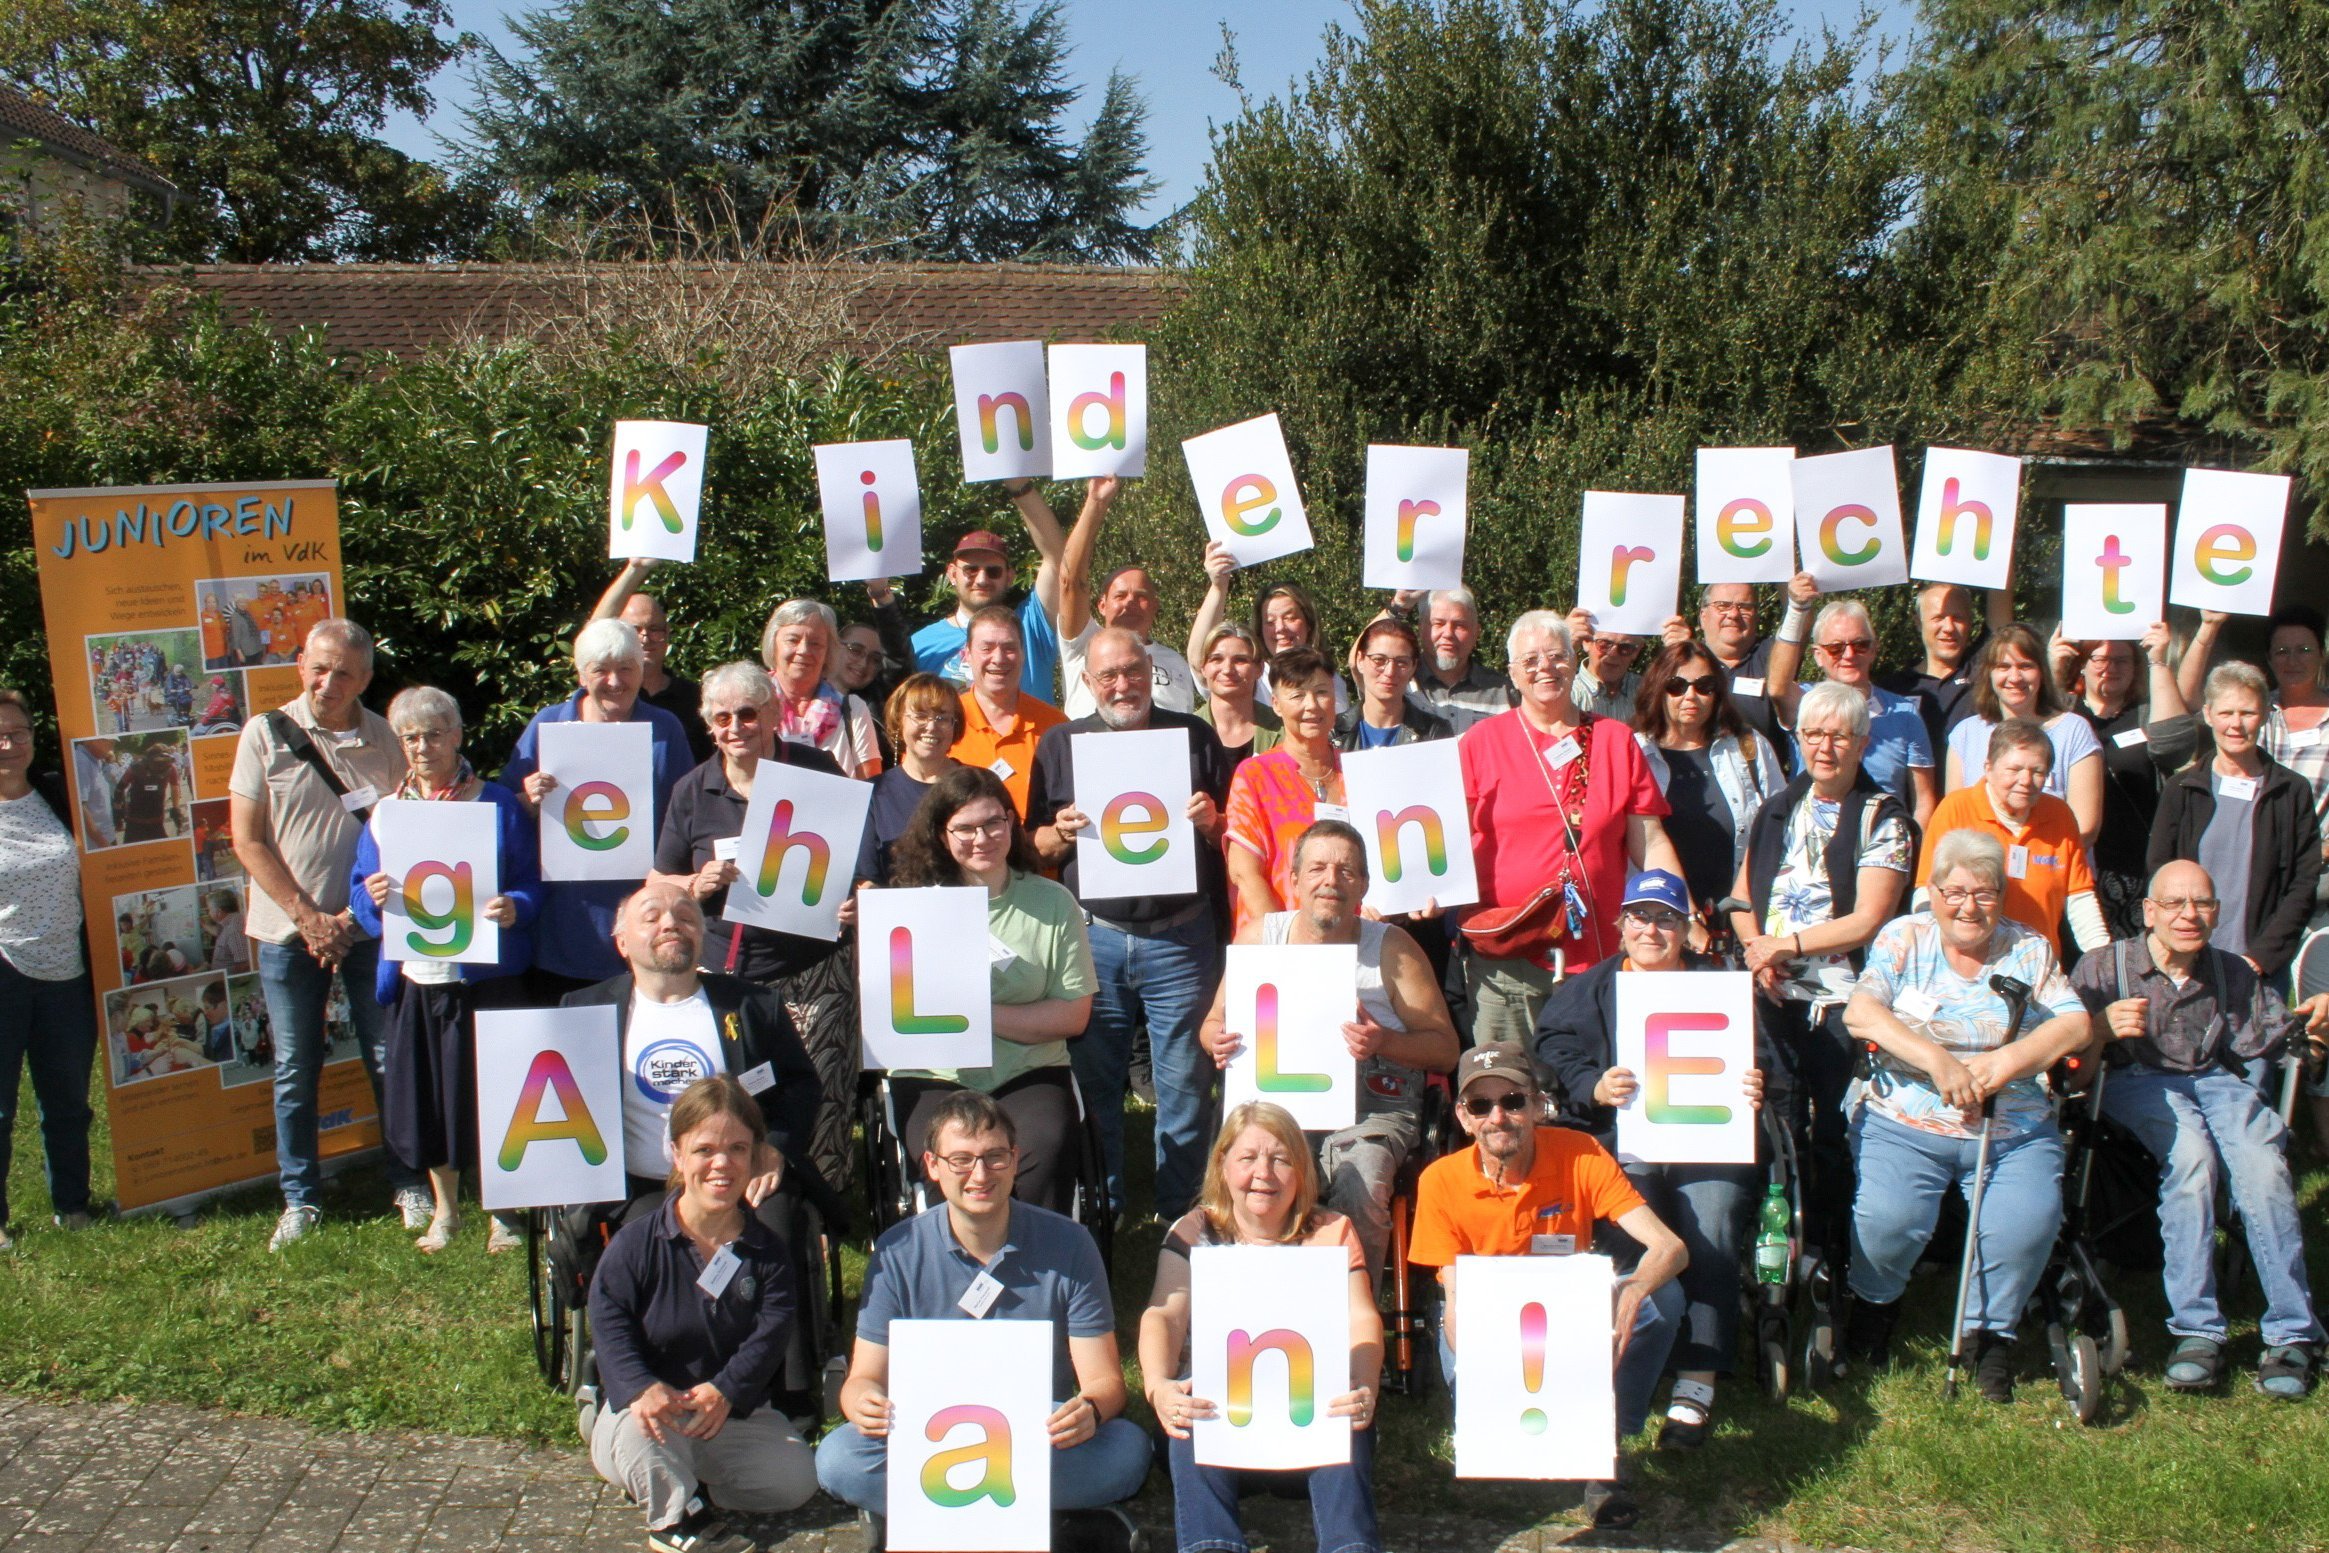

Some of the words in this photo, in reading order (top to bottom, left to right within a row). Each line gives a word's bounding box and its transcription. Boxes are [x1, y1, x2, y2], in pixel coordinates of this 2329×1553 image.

[978, 391, 1032, 452] n
[1067, 371, 1126, 449] d
[51, 495, 293, 559] JUNIOREN
[622, 449, 687, 533] K
[860, 470, 883, 551] i
[1221, 474, 1280, 536] e
[1397, 499, 1440, 561] r
[1716, 498, 1774, 559] e
[1936, 476, 1994, 561] h
[243, 549, 272, 564] im
[282, 542, 328, 562] VdK
[1818, 503, 1882, 567] c
[2096, 534, 2135, 614] t
[2194, 524, 2258, 586] e
[1610, 545, 1654, 606] r
[563, 781, 631, 851] e
[756, 799, 831, 907] h
[1100, 791, 1169, 865] e
[1376, 804, 1448, 883] n
[402, 860, 475, 957] g
[889, 926, 969, 1035] L
[650, 1059, 697, 1069] Kinder
[652, 1068, 698, 1078] stark
[1255, 983, 1332, 1093] L
[1645, 1012, 1733, 1124] E
[499, 1049, 608, 1172] A
[1227, 1329, 1314, 1428] n
[921, 1405, 1014, 1509] a
